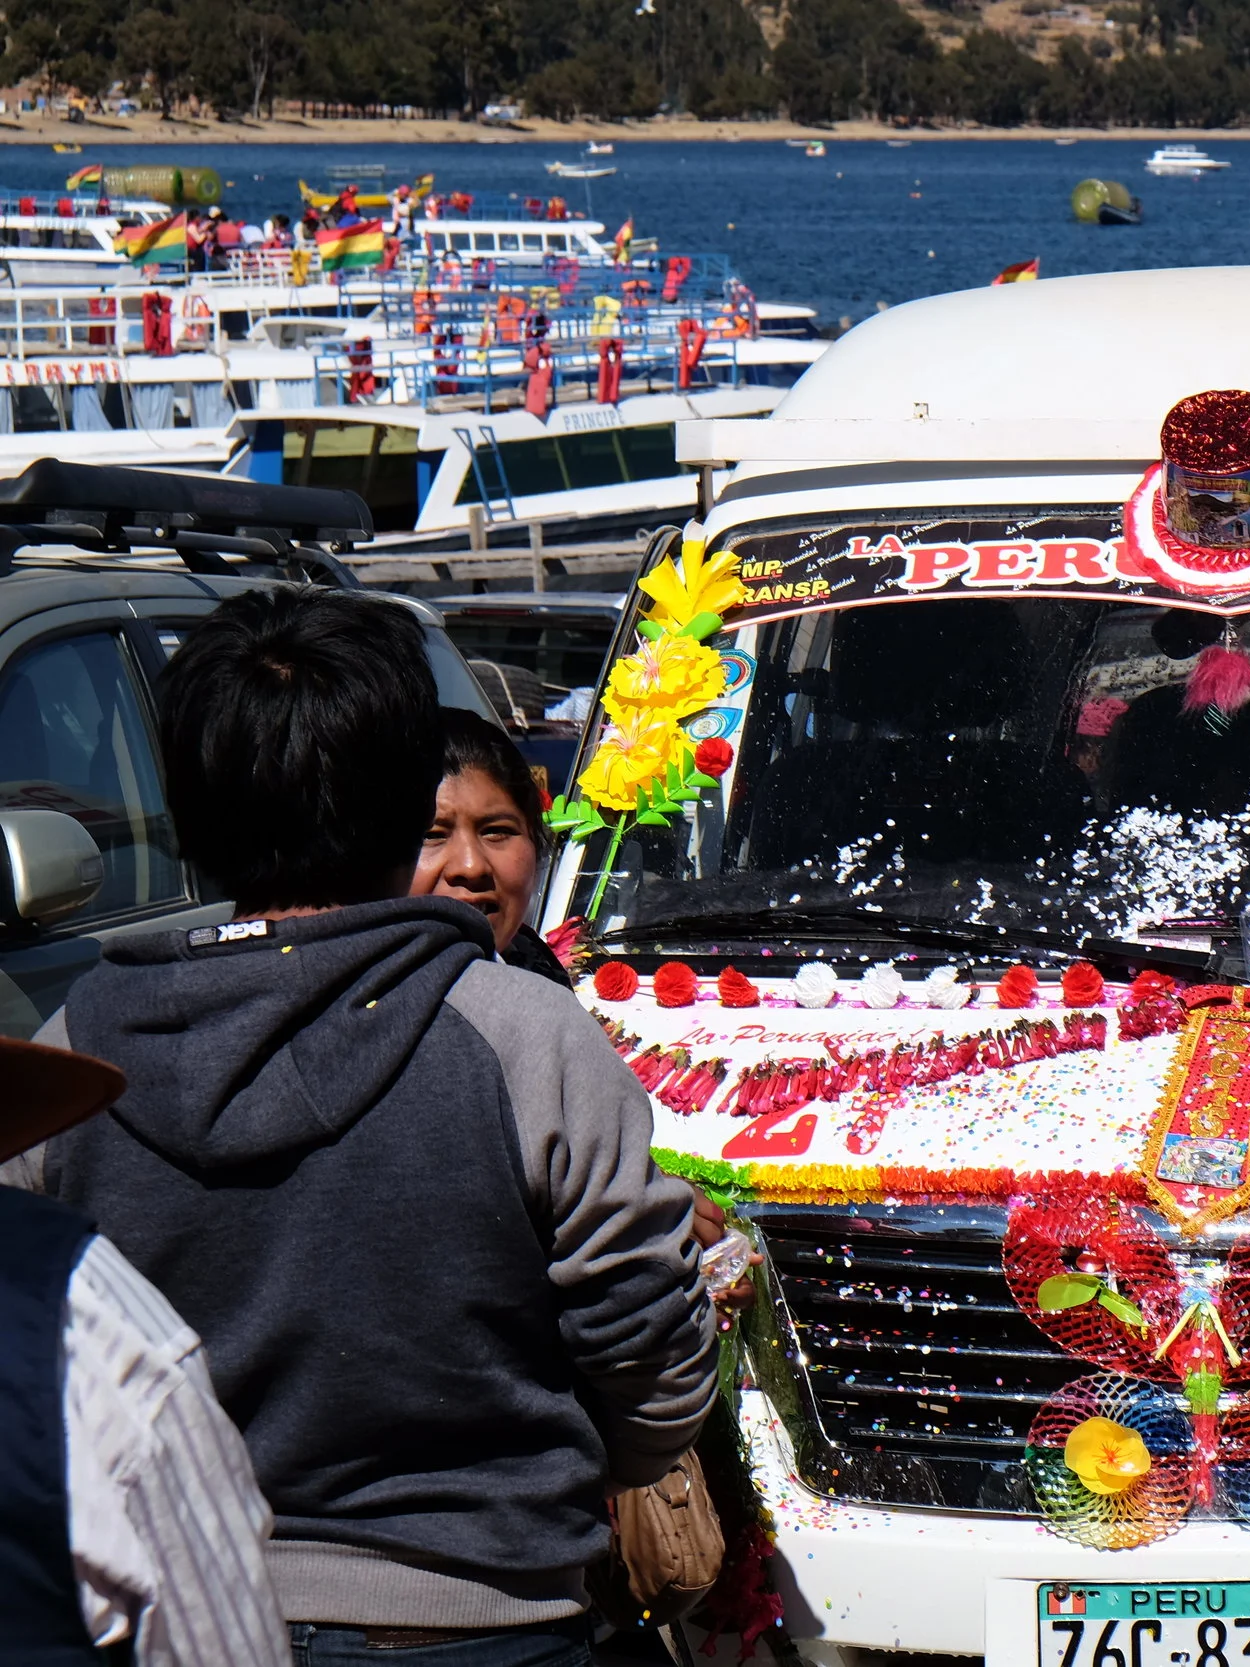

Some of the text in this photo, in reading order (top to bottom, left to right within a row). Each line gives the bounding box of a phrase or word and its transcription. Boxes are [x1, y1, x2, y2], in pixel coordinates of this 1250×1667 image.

[848, 533, 905, 559] LA
[738, 579, 831, 604] RANSP.
[668, 1027, 715, 1047] La
[1131, 1588, 1228, 1615] PERU
